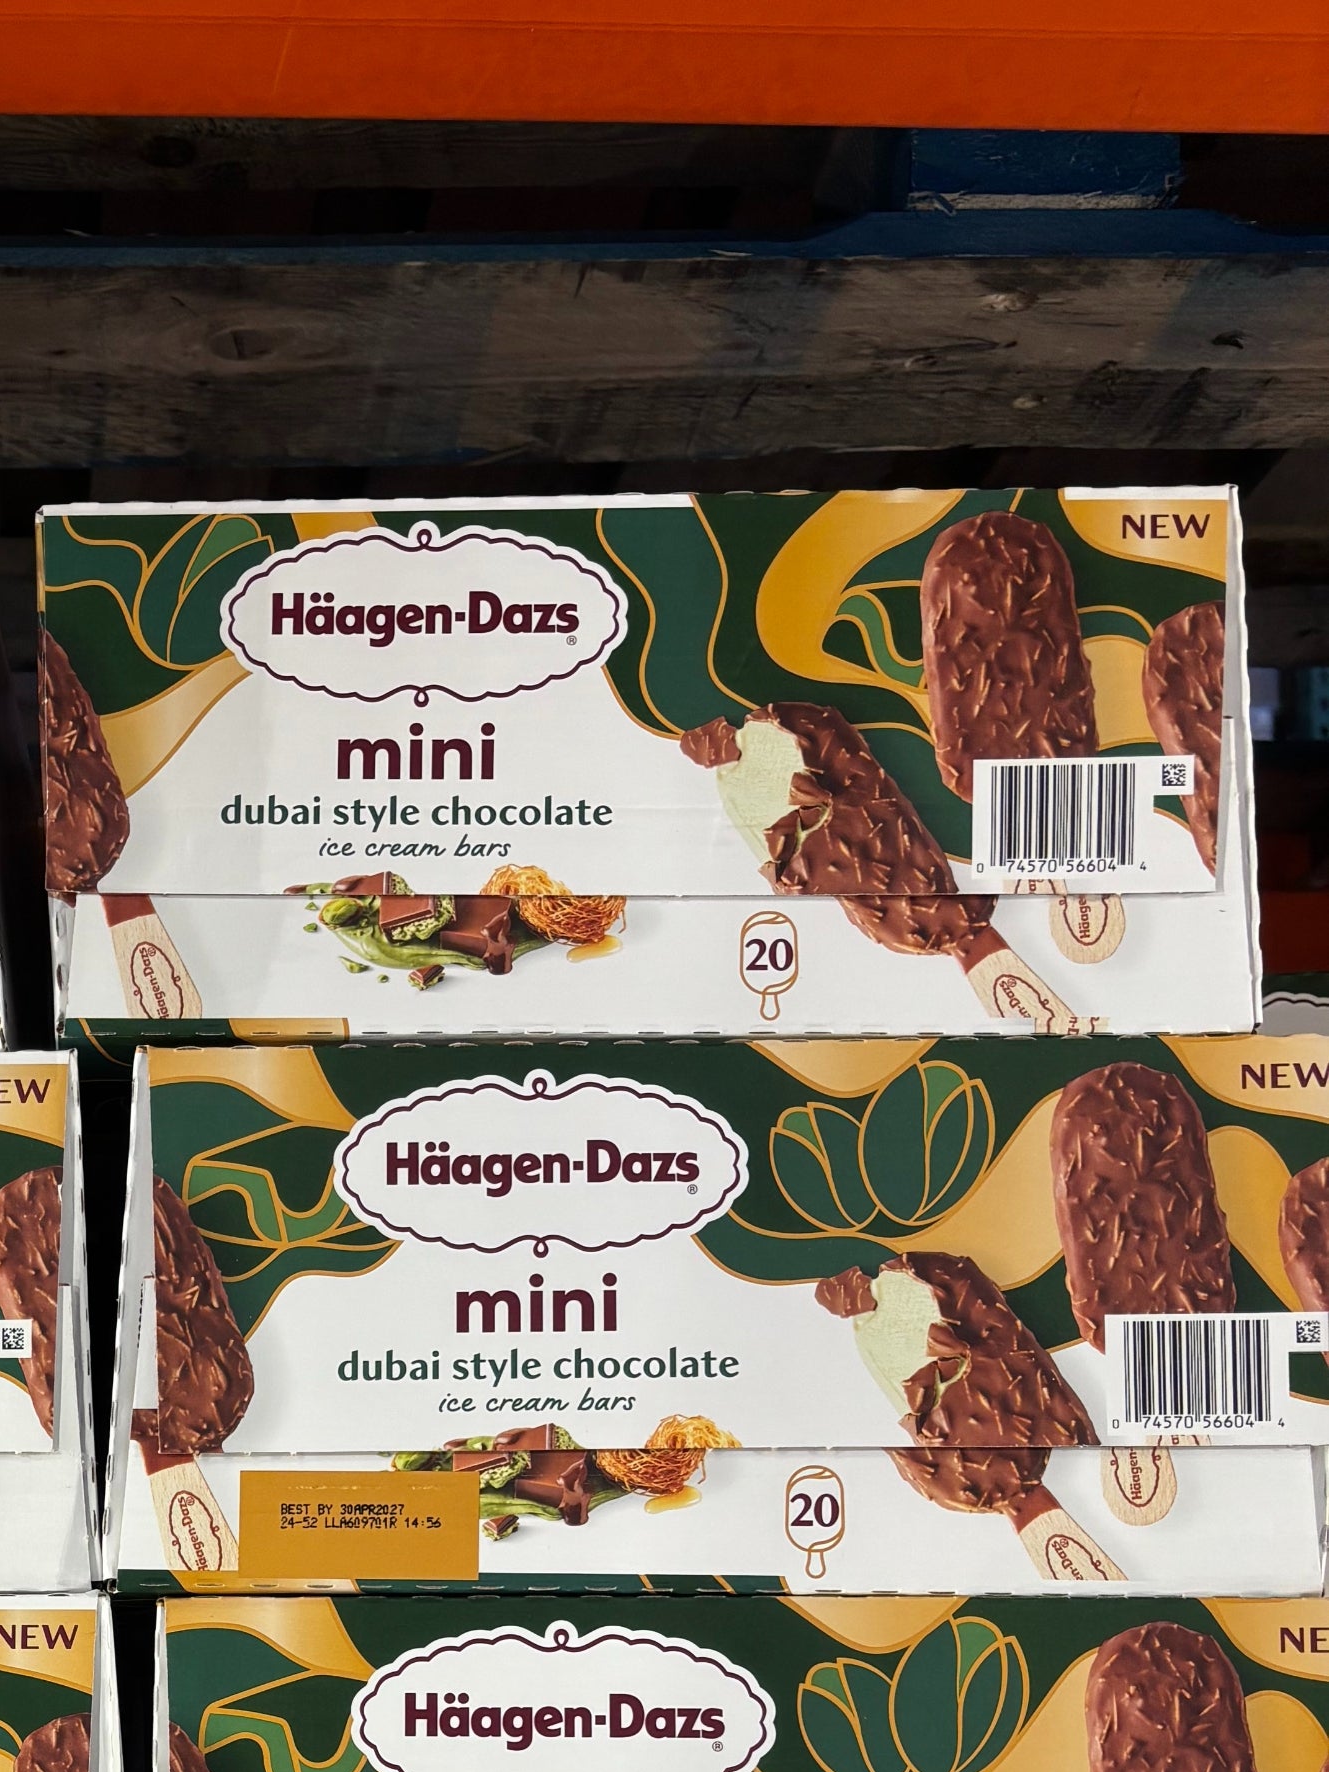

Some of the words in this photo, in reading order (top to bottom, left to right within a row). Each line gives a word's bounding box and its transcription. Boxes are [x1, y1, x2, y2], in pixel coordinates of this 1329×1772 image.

[1122, 514, 1210, 539] NEW
[272, 591, 579, 647] Häagen-Dazs
[338, 723, 495, 779] mini
[221, 794, 320, 824] dubai
[333, 795, 419, 832] style
[432, 795, 612, 825] chocolate
[319, 838, 355, 856] ice
[365, 843, 446, 857] cream
[454, 834, 511, 857] bars
[1007, 859, 1057, 872] 74570
[1065, 859, 1116, 872] 56604
[744, 938, 795, 971] 20
[387, 1140, 699, 1197] Häagen-Dazs
[456, 1273, 617, 1333] mini
[338, 1350, 439, 1381] dubai
[453, 1348, 541, 1387] style
[554, 1347, 739, 1379] chocolate
[439, 1393, 476, 1412] ice
[486, 1398, 569, 1412] cream
[577, 1387, 636, 1411] bars
[1143, 1415, 1194, 1428] 74570
[1203, 1414, 1254, 1428] 56604
[280, 1517, 318, 1529] 24-52
[404, 1517, 441, 1529] 14:56
[281, 1503, 310, 1515] BEST
[318, 1504, 333, 1515] BY
[340, 1504, 405, 1516] 30APR2027
[790, 1493, 839, 1527] 20
[405, 1693, 725, 1752] Häagen-Dazs
